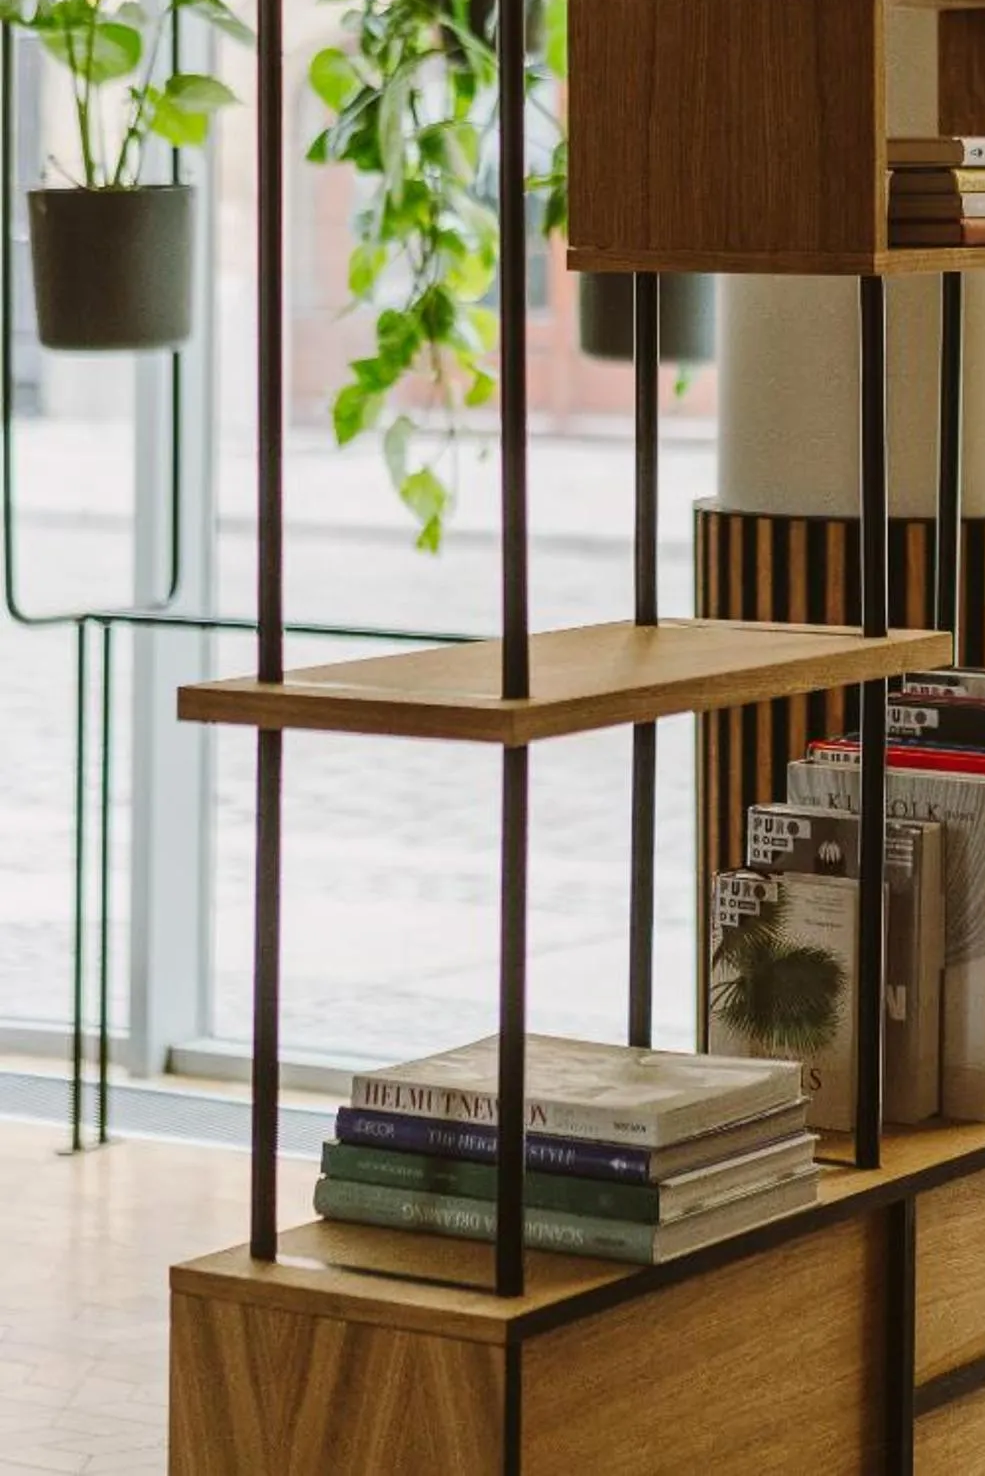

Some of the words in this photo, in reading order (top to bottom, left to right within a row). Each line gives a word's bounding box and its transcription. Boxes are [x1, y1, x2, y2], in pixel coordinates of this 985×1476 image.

[887, 708, 927, 725] URO
[828, 792, 938, 821] KIOLK
[753, 817, 799, 835] PURO
[719, 881, 766, 901] PURO
[364, 1082, 457, 1112] HELMUT
[402, 1202, 480, 1232] DREAMING
